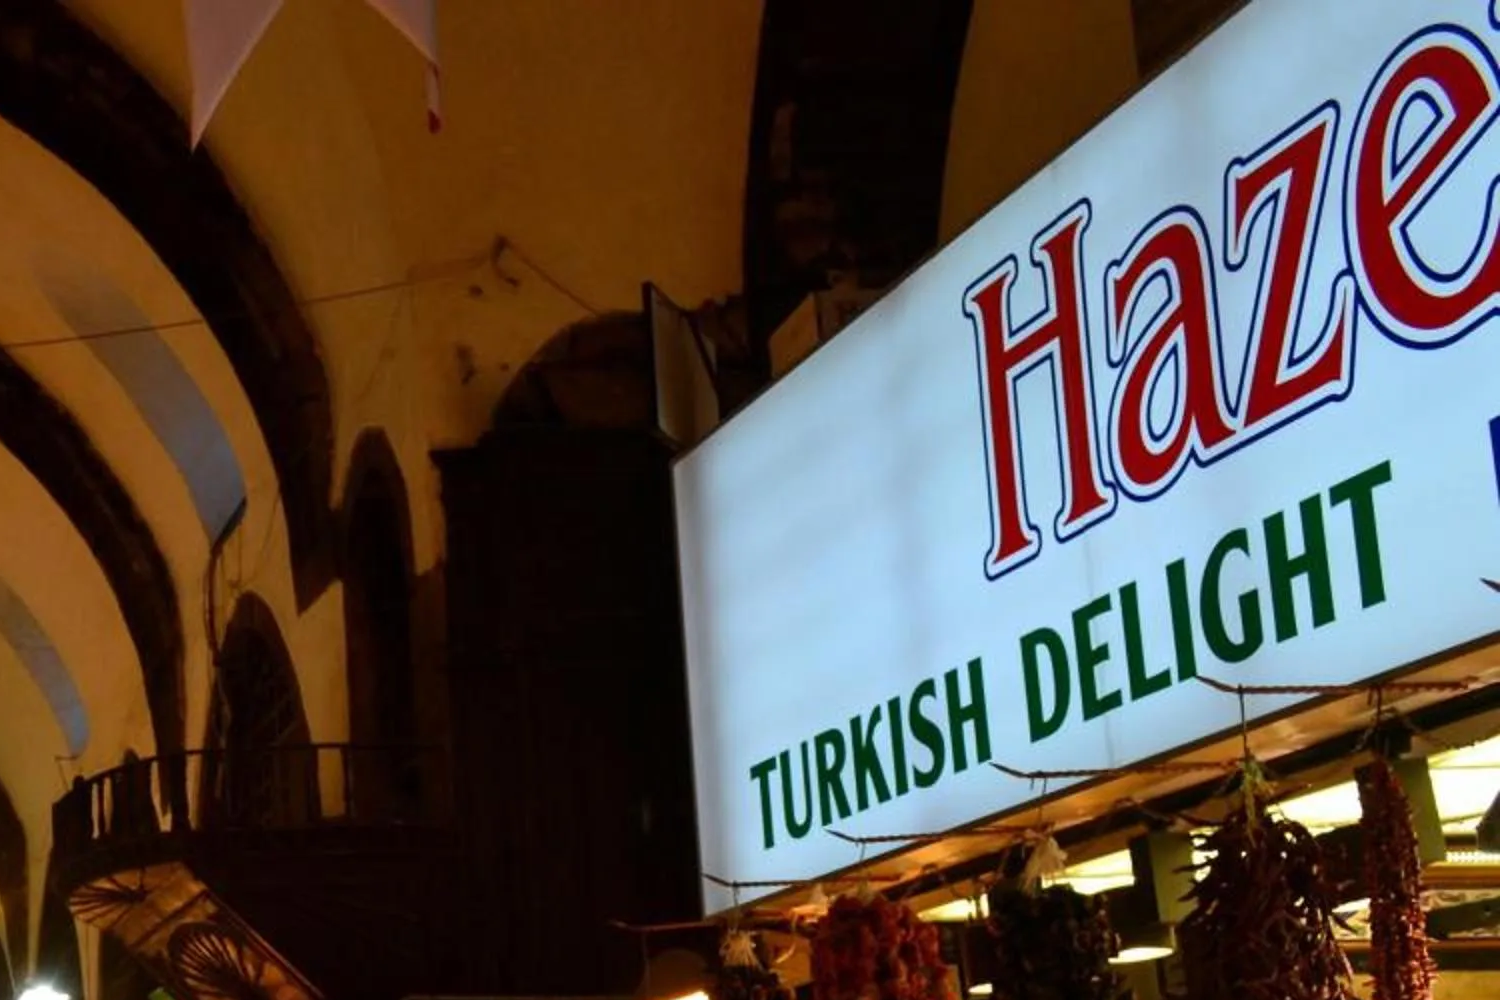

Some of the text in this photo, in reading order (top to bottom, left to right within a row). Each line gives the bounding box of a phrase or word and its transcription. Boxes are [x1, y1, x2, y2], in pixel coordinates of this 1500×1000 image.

[963, 12, 1500, 580] Haze
[750, 656, 993, 850] TURKISH
[1018, 460, 1393, 743] DELIGHT
